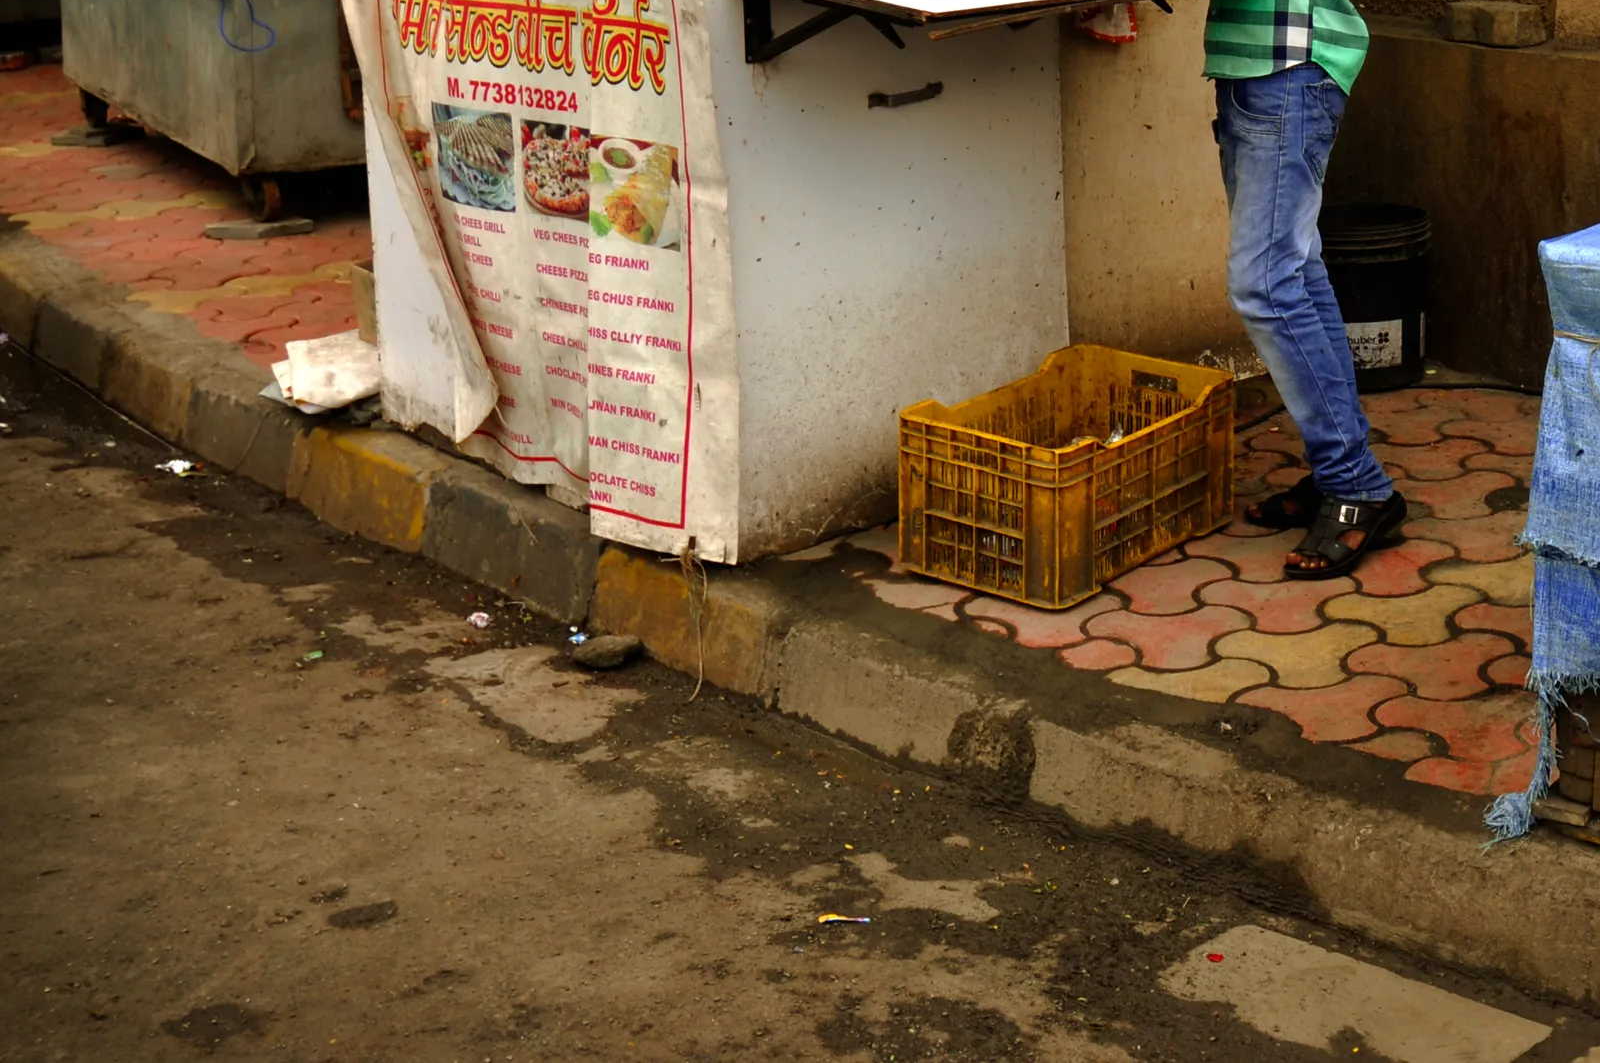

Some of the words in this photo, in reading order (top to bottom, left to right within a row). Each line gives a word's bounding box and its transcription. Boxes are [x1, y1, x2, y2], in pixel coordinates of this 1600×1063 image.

[447, 77, 464, 99] M.
[469, 80, 578, 113] 7738132824
[484, 221, 506, 234] GRILL
[533, 228, 550, 241] VEG
[552, 231, 578, 245] CHEES
[471, 252, 493, 267] CHEES
[588, 253, 602, 264] EG
[605, 255, 649, 271] FRIANKI
[536, 263, 568, 278] CHEESE
[587, 289, 600, 301] EG
[602, 292, 634, 306] CHUS
[636, 296, 674, 313] FRANKI
[542, 331, 566, 346] CHEES
[645, 335, 682, 352] FRANKI
[616, 368, 656, 385] FRANKI
[587, 399, 617, 415] JWAN
[620, 405, 656, 423] FRANKI
[611, 440, 640, 455] CHISS
[641, 447, 680, 464] FRANKI
[589, 471, 628, 490] OCLATE
[630, 480, 656, 497] CHISS
[588, 489, 612, 504] ANKI
